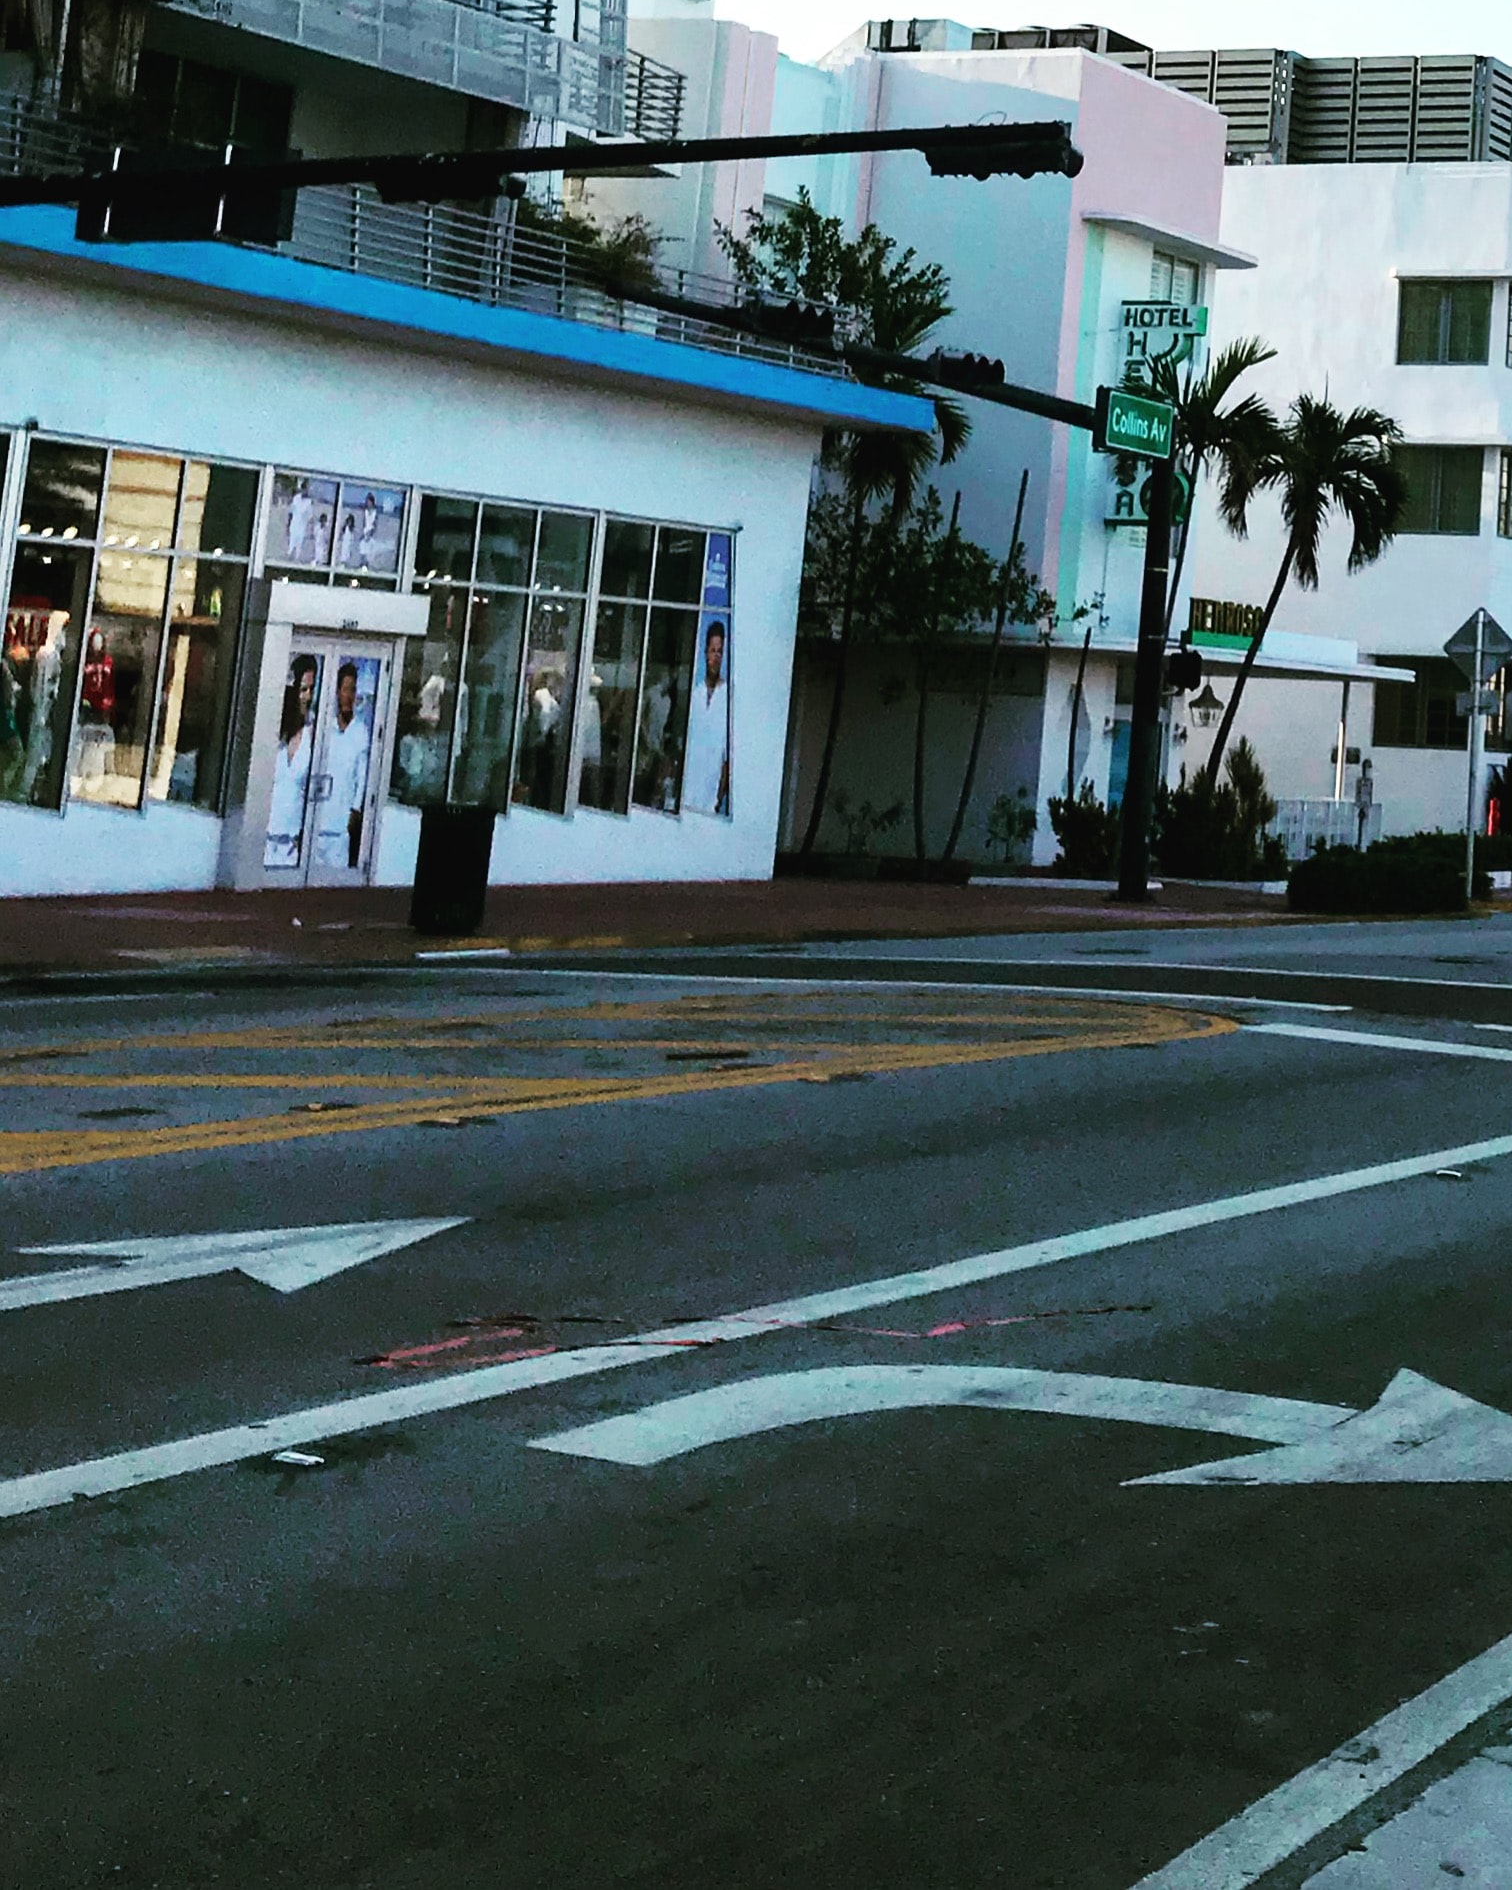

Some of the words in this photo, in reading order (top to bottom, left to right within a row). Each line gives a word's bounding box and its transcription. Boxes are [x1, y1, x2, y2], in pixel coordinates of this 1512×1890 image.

[1124, 307, 1193, 327] HOTEL
[1112, 406, 1149, 439] Collins
[1150, 416, 1167, 443] Av
